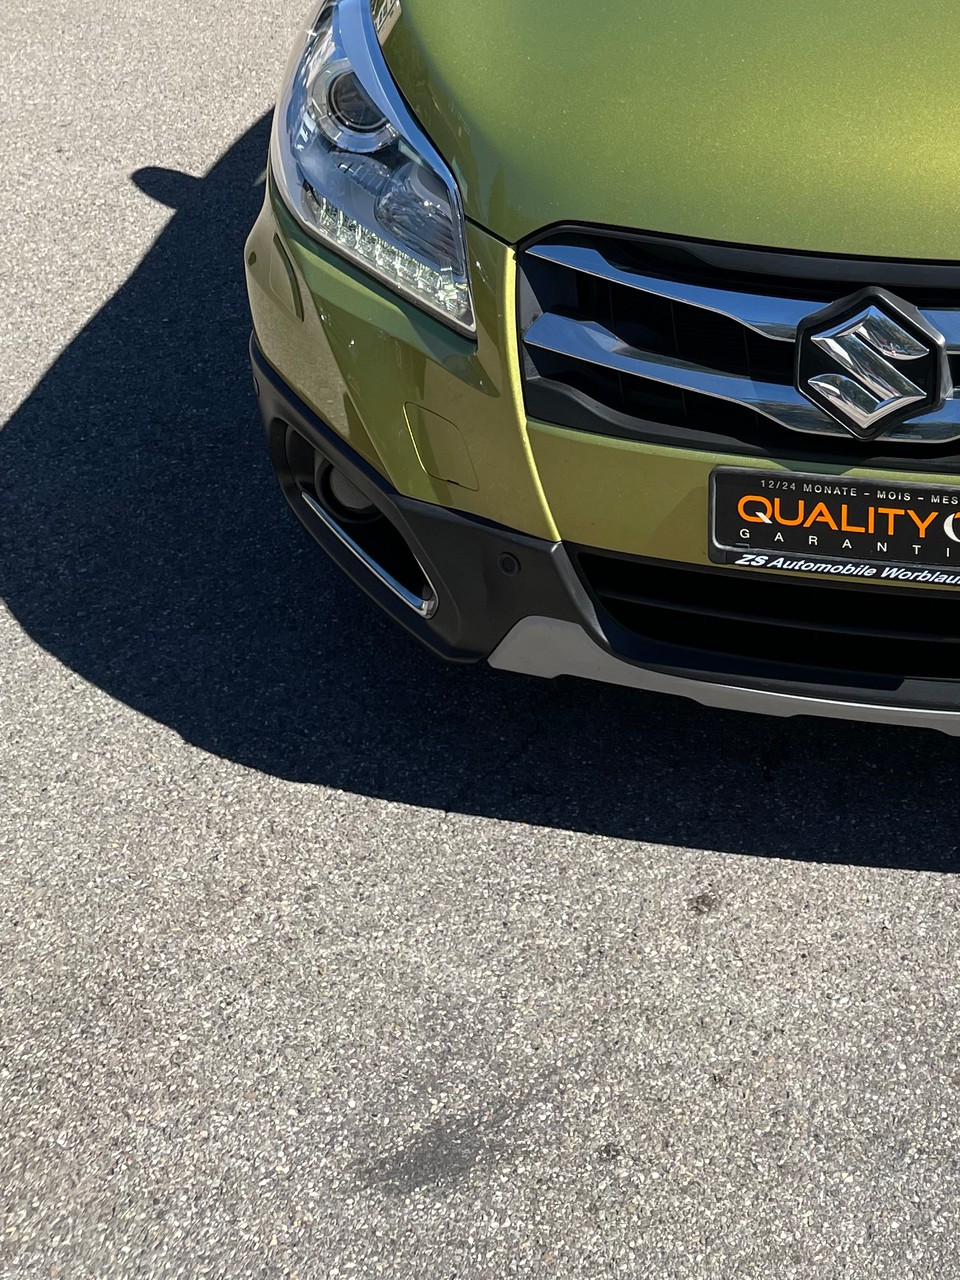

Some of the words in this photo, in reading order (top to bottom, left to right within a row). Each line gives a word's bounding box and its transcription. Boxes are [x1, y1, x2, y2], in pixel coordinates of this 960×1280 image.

[760, 480, 796, 491] 12/24
[803, 483, 858, 497] MONATE
[876, 490, 911, 502] MOIS
[734, 554, 769, 566] ZS
[766, 557, 877, 577] Automobile
